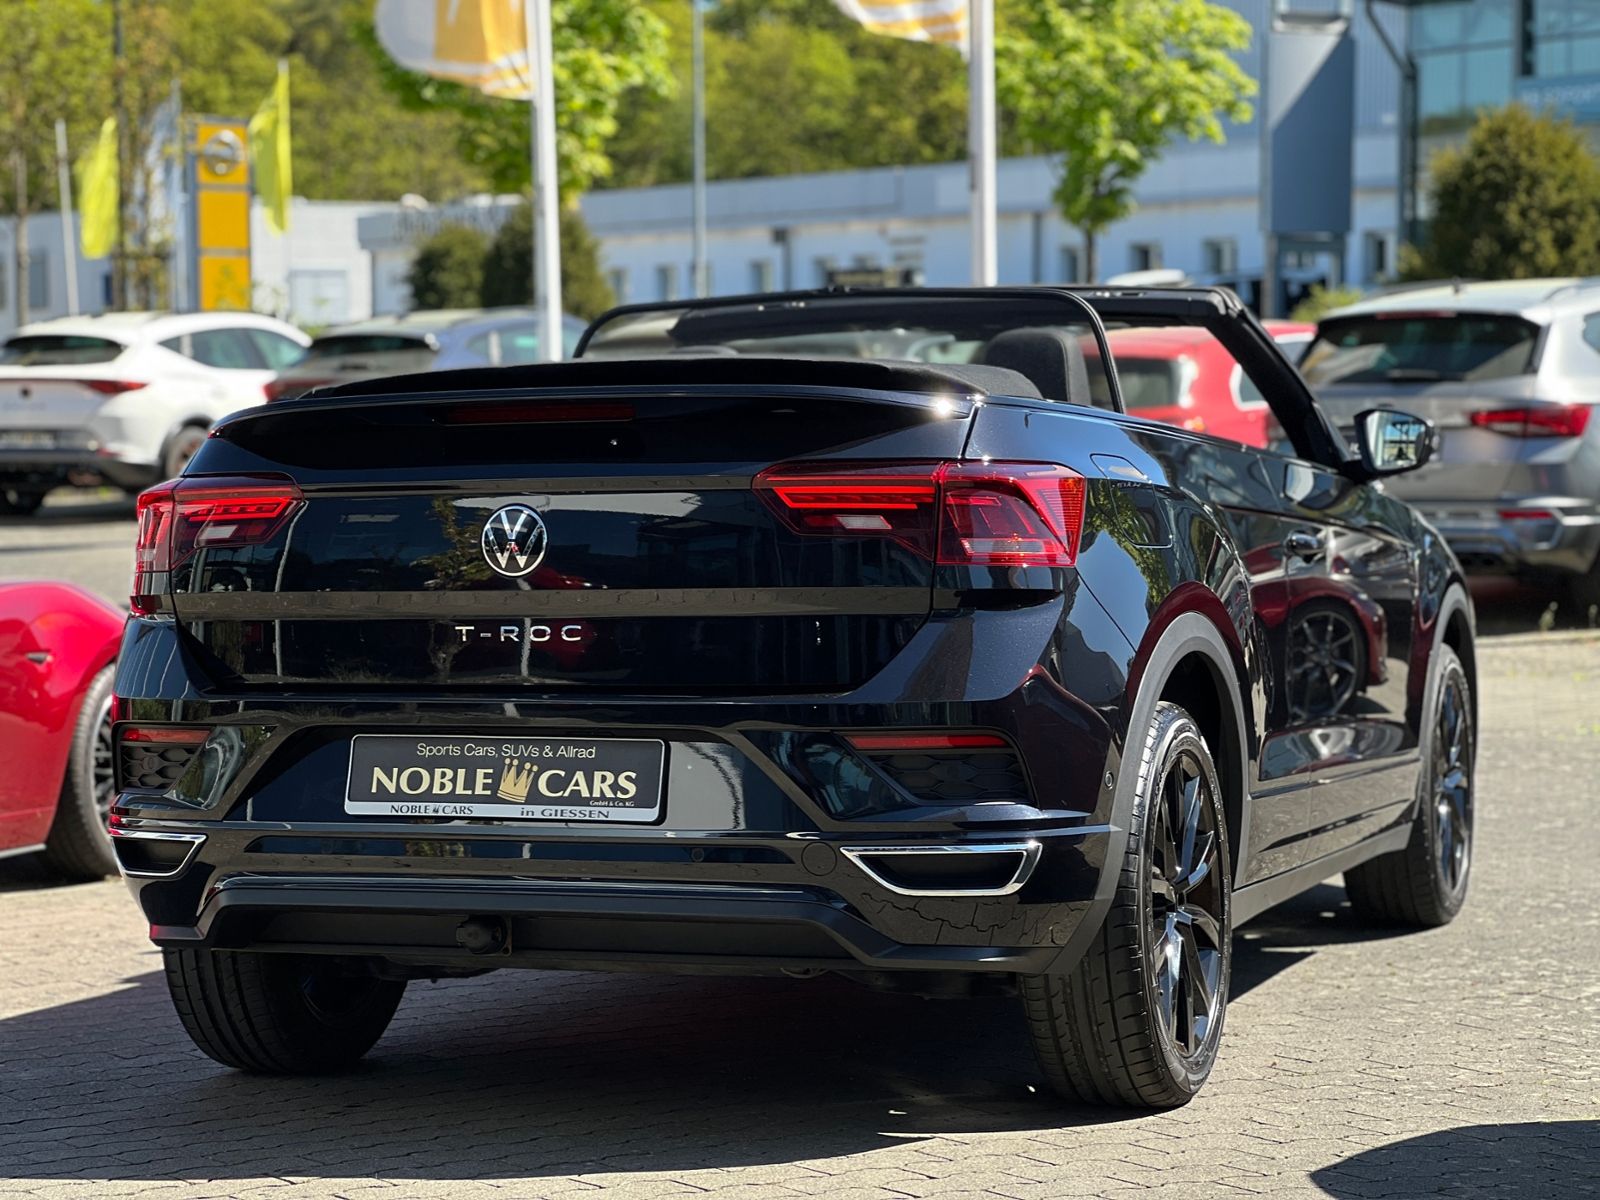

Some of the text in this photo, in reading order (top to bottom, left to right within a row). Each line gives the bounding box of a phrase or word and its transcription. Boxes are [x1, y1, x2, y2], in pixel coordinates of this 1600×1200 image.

[455, 625, 582, 642] T-ROC
[416, 743, 596, 759] Sports Cars, SUVs & Allrad
[370, 766, 637, 799] NOBLE CARS
[390, 804, 474, 815] NOBLE CARS
[520, 807, 609, 818] in GIESSEN
